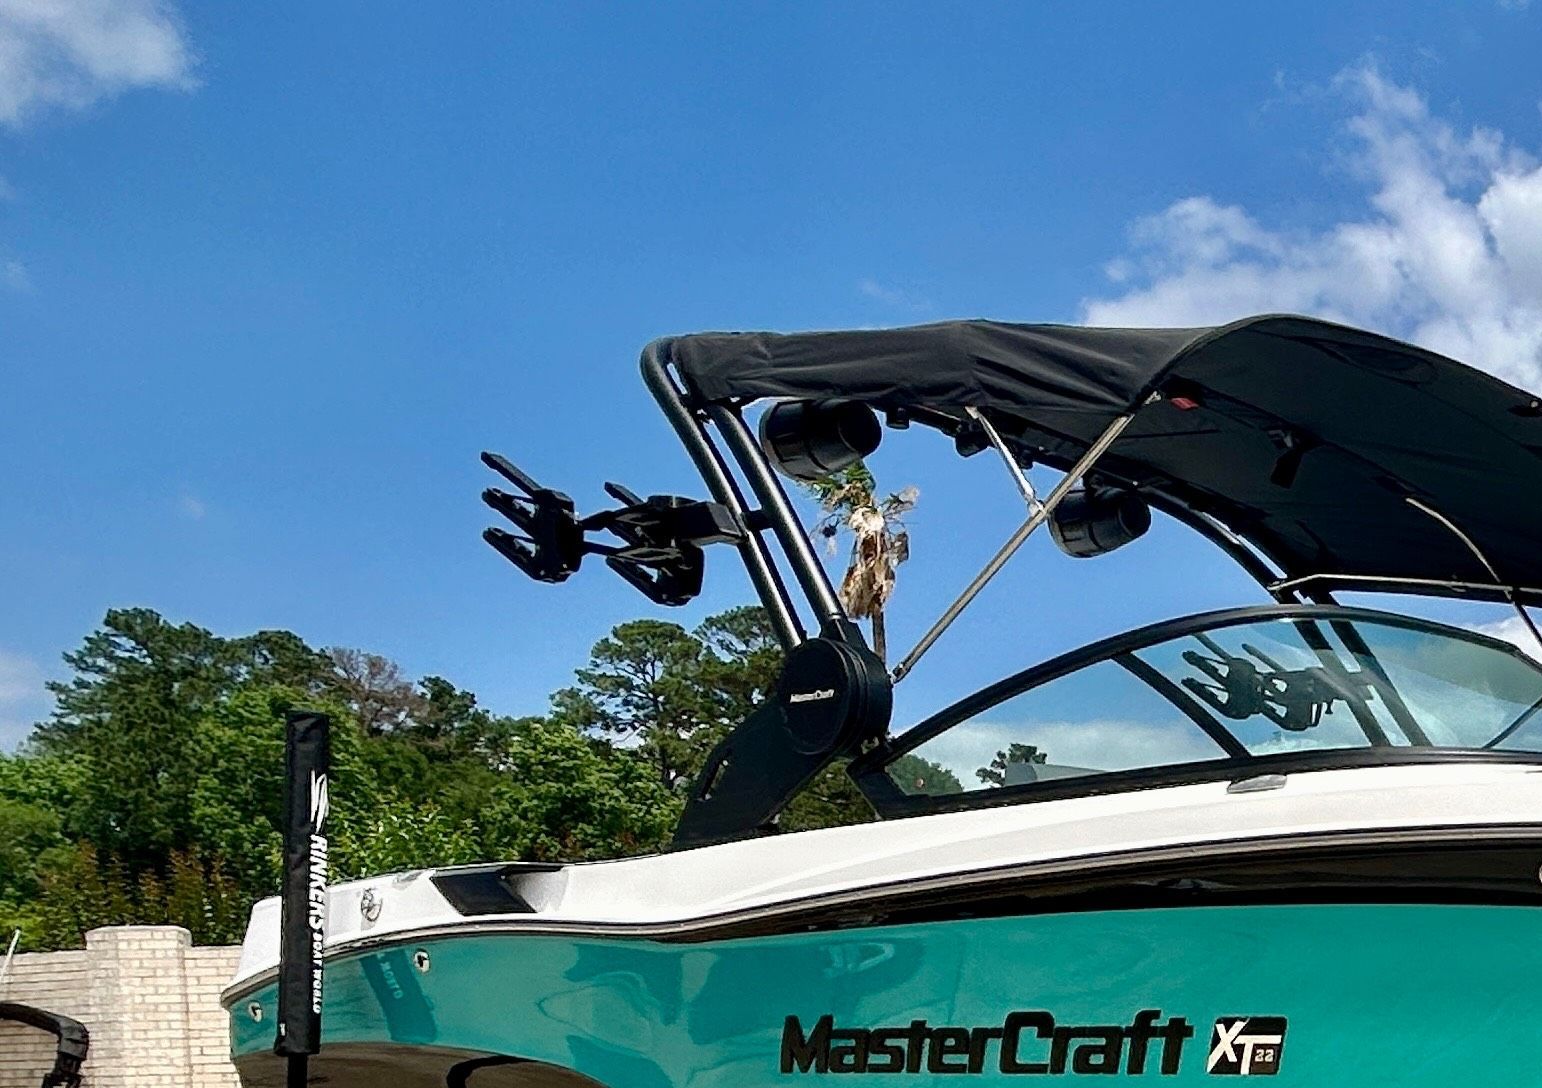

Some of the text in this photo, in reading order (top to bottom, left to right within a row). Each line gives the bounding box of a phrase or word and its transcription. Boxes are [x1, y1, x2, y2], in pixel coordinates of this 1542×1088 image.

[309, 834, 328, 1014] RINKERS BOAT WORLD
[780, 1009, 1283, 1075] MasterCraft XT 22
